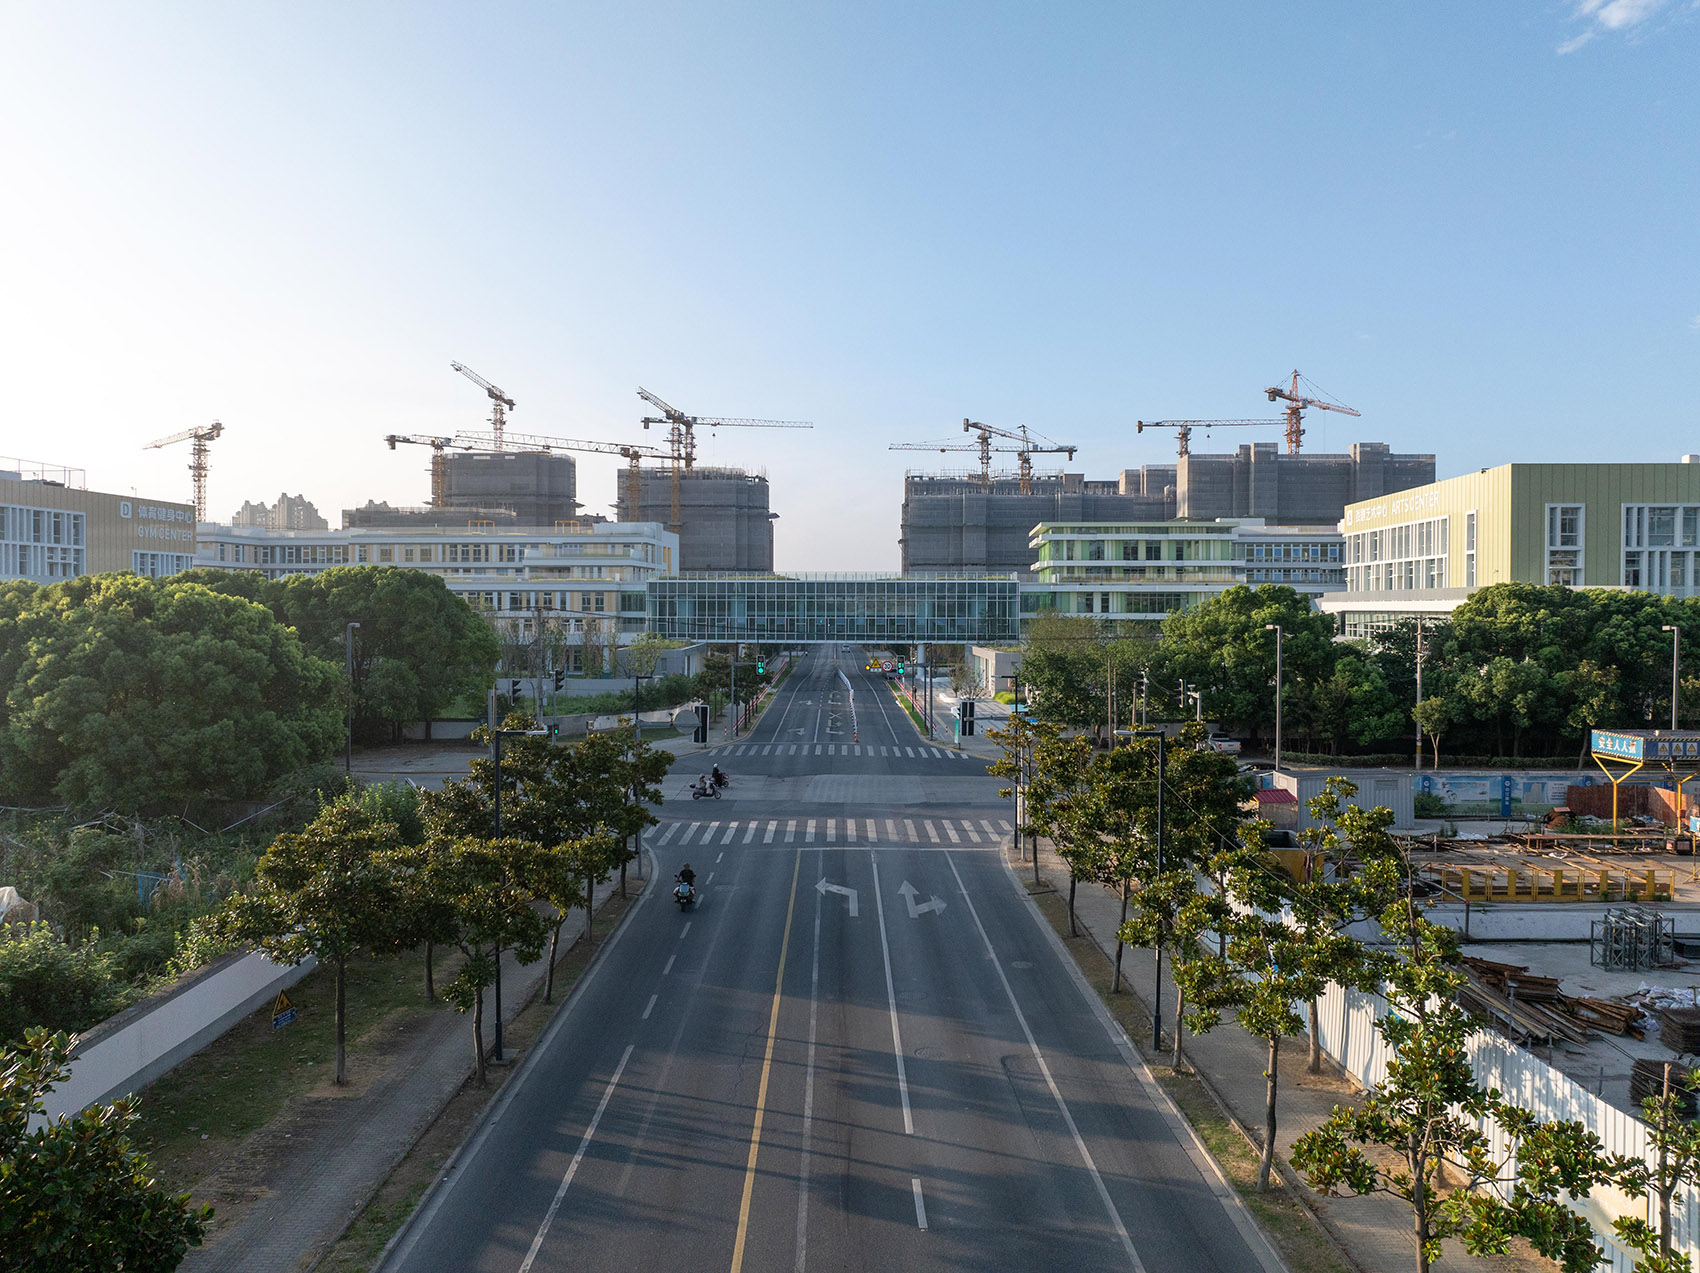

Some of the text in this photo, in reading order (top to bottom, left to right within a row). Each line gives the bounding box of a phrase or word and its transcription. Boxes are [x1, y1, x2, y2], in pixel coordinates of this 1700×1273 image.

[1391, 491, 1440, 515] ARTS CENTER
[138, 505, 194, 524] 体育健身中心
[138, 525, 193, 542] GYM CENTER
